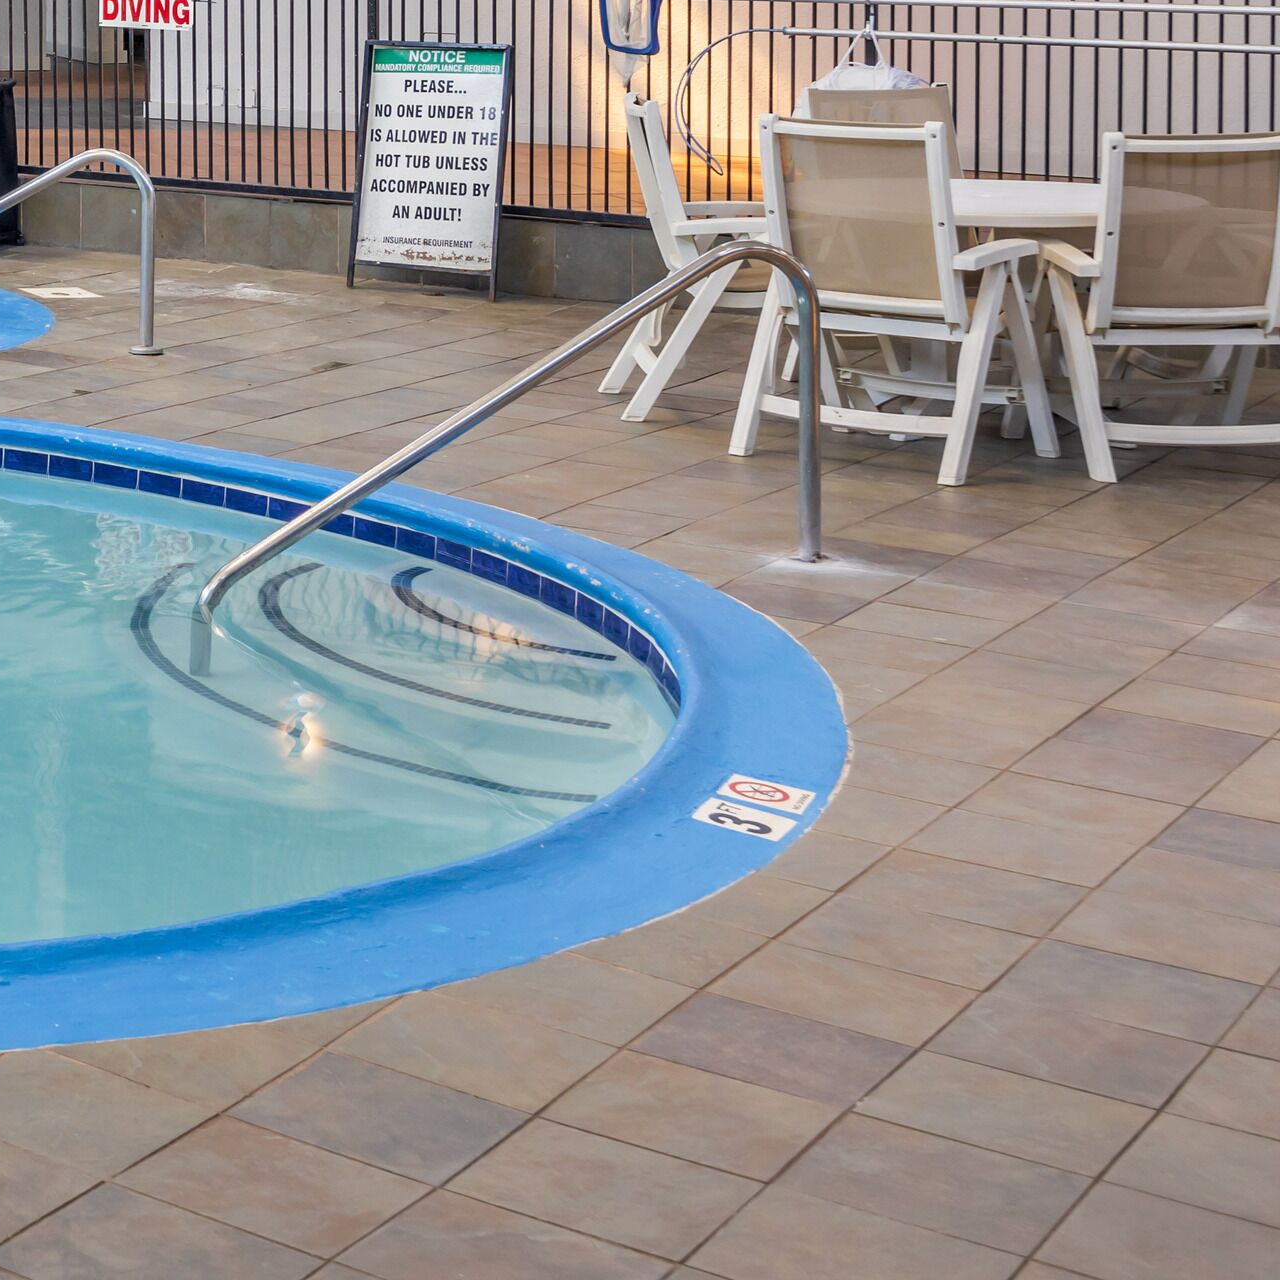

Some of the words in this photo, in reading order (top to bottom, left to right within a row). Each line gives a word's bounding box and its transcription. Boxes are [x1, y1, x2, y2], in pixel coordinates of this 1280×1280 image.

[408, 50, 467, 63] NOTICE
[375, 63, 416, 72] MANDATORY
[418, 64, 463, 72] COMPLIANCE
[463, 64, 500, 73] REQUIRED
[404, 79, 467, 94] PLEASE...
[374, 104, 392, 118] NO
[396, 104, 423, 118] ONE
[427, 105, 474, 120] UNDER
[479, 107, 497, 120] 18
[370, 129, 382, 142] IS
[385, 129, 447, 144] ALLOWED
[452, 131, 466, 145] IN
[471, 132, 498, 146] THE
[375, 154, 401, 168] HOT
[405, 155, 431, 169] TUB
[435, 156, 488, 171] UNLESS
[370, 179, 467, 196] ACCOMPANIED
[472, 183, 490, 197] BY
[392, 205, 410, 219] AN
[414, 206, 462, 221] ADULT!
[382, 236, 421, 246] INSURANCE
[423, 238, 473, 248] REQUIREMENT
[708, 812, 772, 835] 3
